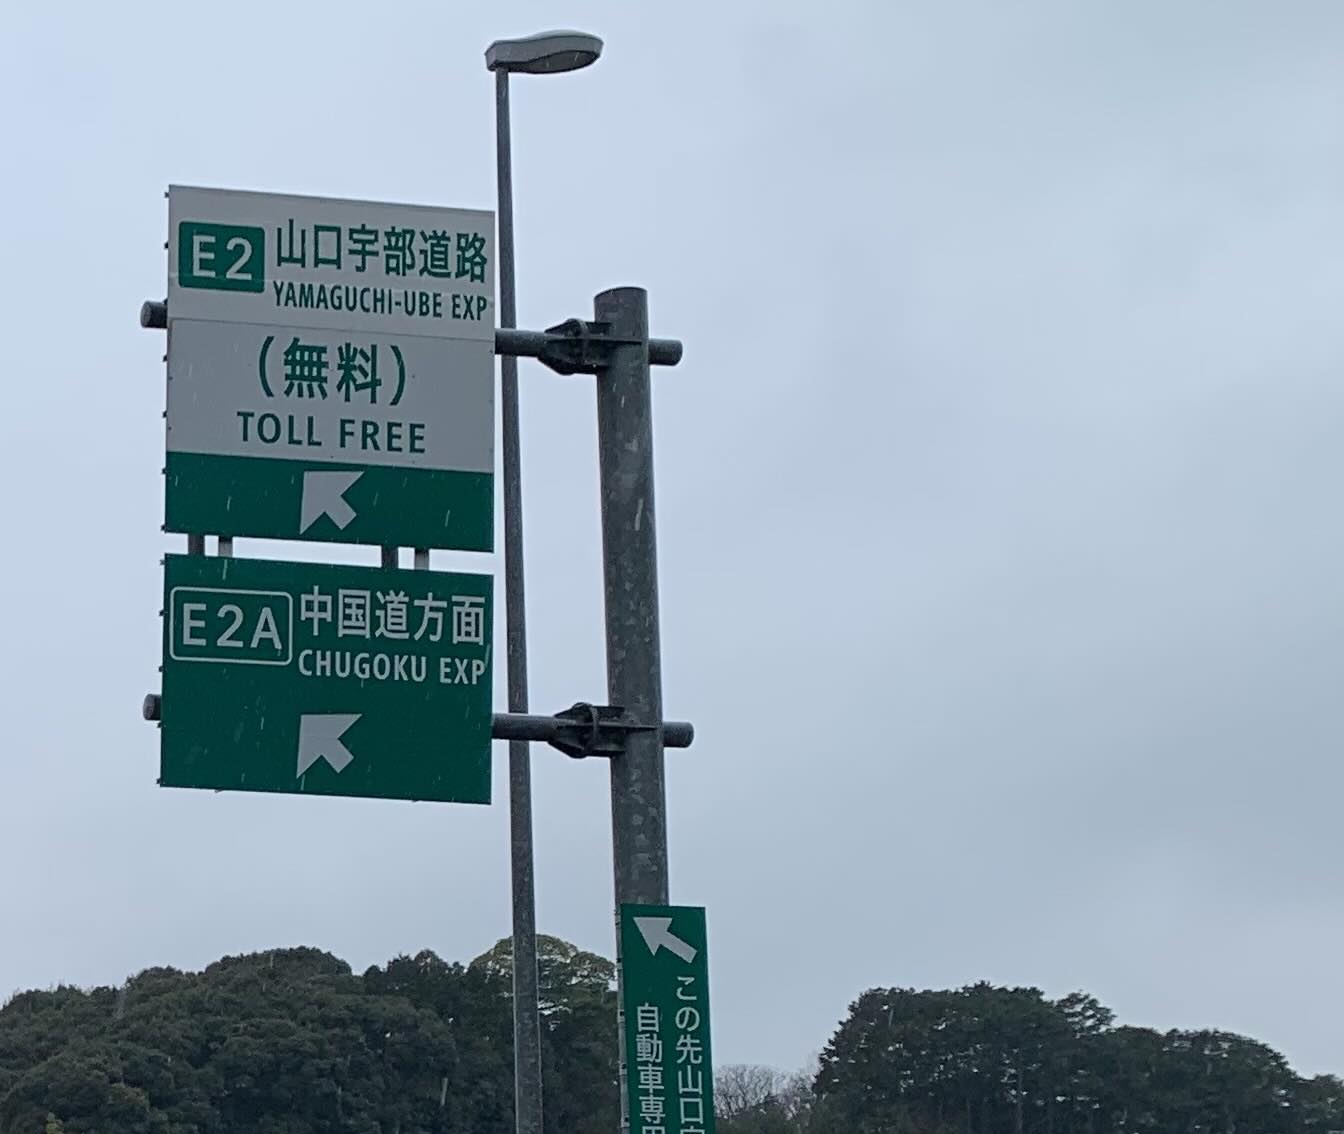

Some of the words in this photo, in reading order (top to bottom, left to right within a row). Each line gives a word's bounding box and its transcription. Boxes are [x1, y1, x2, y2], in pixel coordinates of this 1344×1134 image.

[193, 235, 253, 280] E2
[276, 219, 488, 283] 山口宇部道路
[273, 281, 442, 318] YAMAGUCHI-UBE
[452, 294, 487, 321] EXP
[237, 411, 322, 447] TOLL
[340, 418, 426, 454] FREE
[182, 602, 282, 650] E2A
[300, 585, 486, 646] 中国道方面
[298, 649, 427, 682] CHUGOKU
[440, 657, 486, 685] EXP
